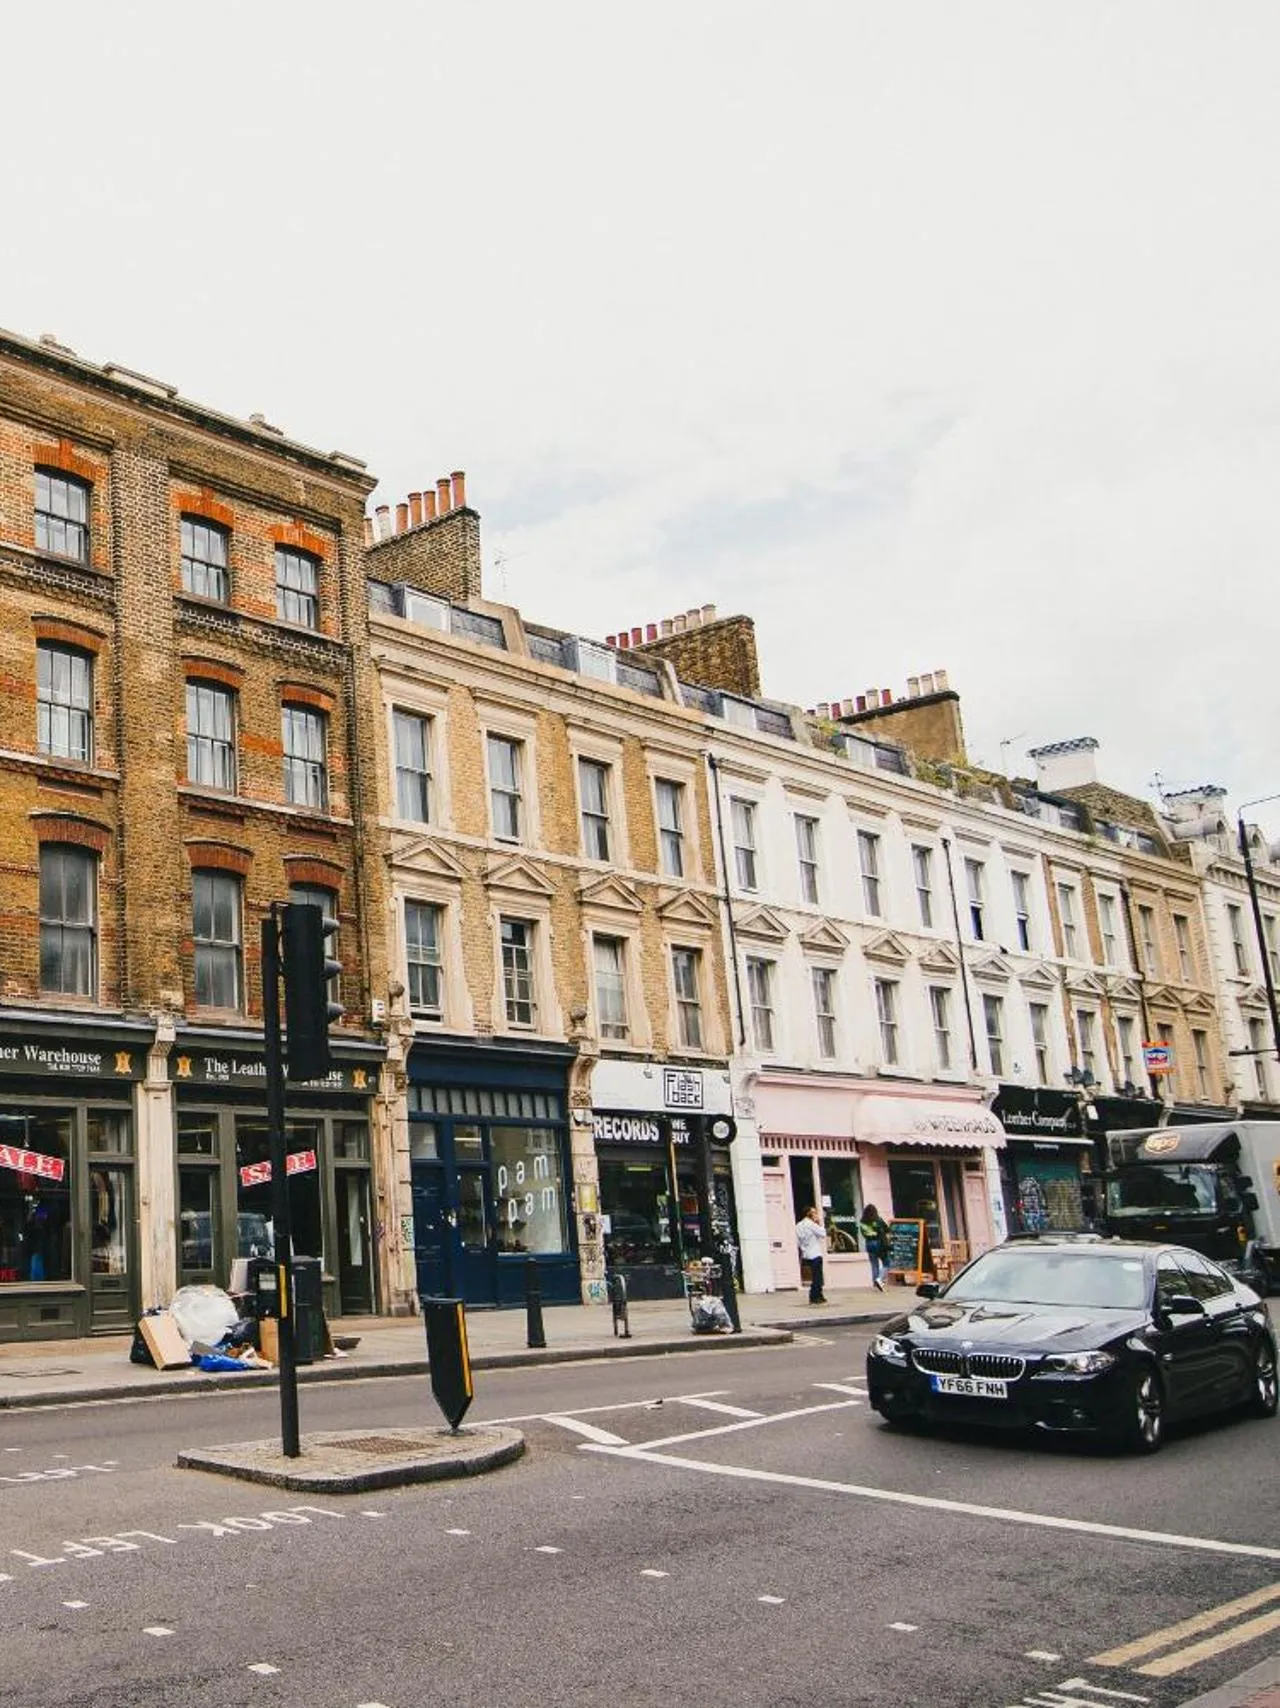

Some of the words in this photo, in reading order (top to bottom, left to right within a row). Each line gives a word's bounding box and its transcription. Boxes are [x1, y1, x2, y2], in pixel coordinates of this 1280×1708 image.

[23, 1045, 102, 1066] Warehouse
[204, 1057, 229, 1073] The
[232, 1059, 267, 1077] Leath
[593, 1115, 660, 1142] RECORDS
[671, 1118, 687, 1130] WE
[671, 1131, 691, 1144] BUY
[497, 1154, 550, 1197] pam
[507, 1185, 558, 1229] pam
[938, 1377, 974, 1394] YF66
[976, 1380, 1006, 1397] FNH
[176, 1504, 346, 1538] LOOK
[10, 1529, 177, 1567] LEFT
